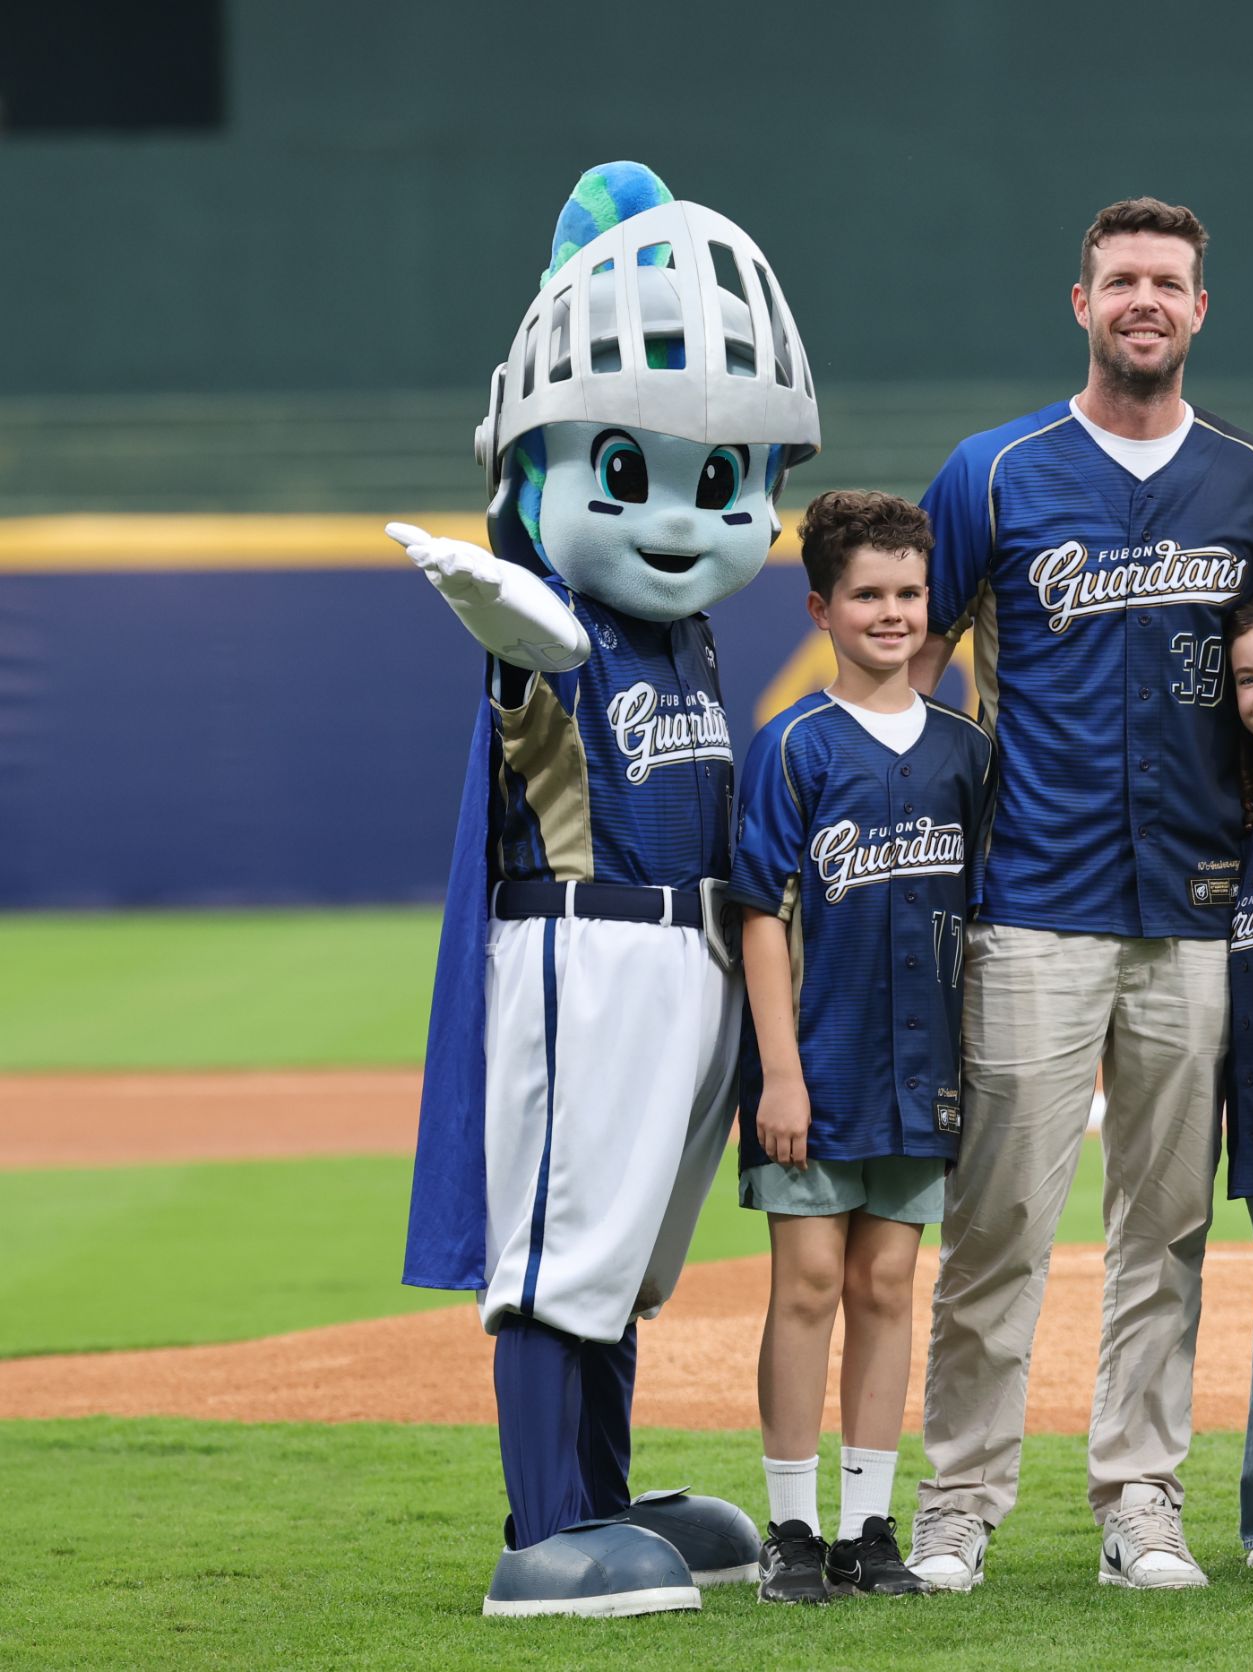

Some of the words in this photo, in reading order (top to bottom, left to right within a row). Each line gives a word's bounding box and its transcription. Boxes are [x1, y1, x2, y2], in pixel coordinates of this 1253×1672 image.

[1098, 545, 1153, 563] FUBON
[1028, 539, 1248, 635] Guardians
[1170, 632, 1226, 708] 39
[660, 694, 697, 707] FUBON
